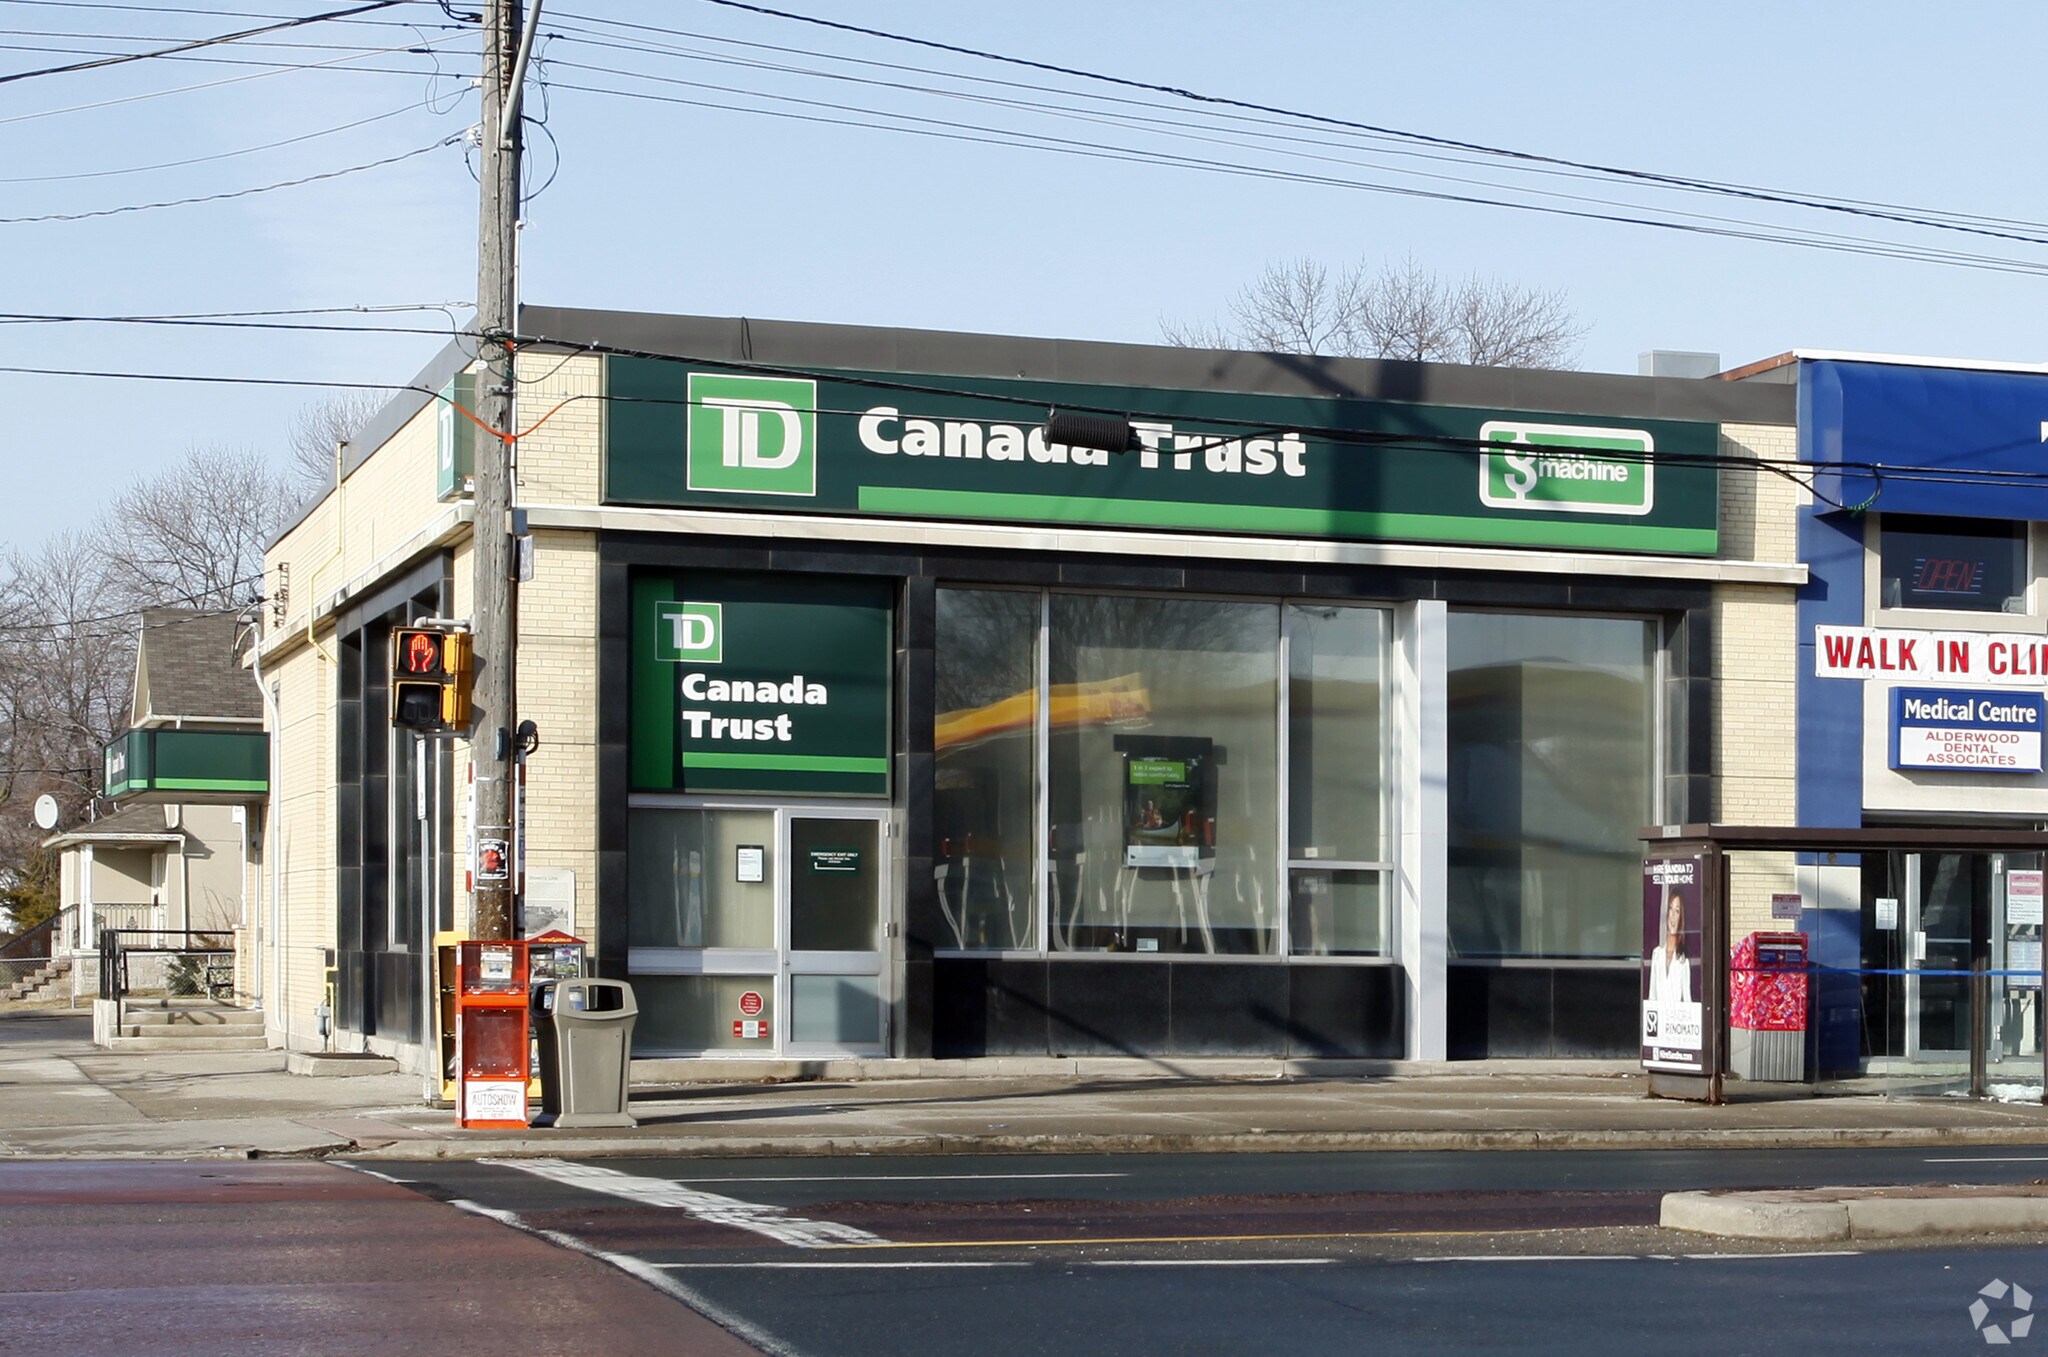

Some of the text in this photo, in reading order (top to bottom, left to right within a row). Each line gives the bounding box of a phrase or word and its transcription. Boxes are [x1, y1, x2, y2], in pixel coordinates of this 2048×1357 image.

[701, 397, 802, 469] TD
[1128, 421, 1306, 477] Trust
[1538, 459, 1629, 483] machine
[1918, 558, 1977, 592] OPEN
[662, 613, 715, 650] TD
[1824, 635, 1918, 671] WALK
[1937, 640, 1970, 673] IN
[681, 673, 828, 705] Canada
[1904, 698, 2037, 723] Medical Centre
[682, 710, 792, 741] Trust
[1925, 731, 2020, 744] ALDERWOOD
[1926, 753, 2016, 766] ASSOCIATES
[1944, 742, 1998, 754] DENTAL
[472, 1094, 517, 1106] AUTOSHOW
